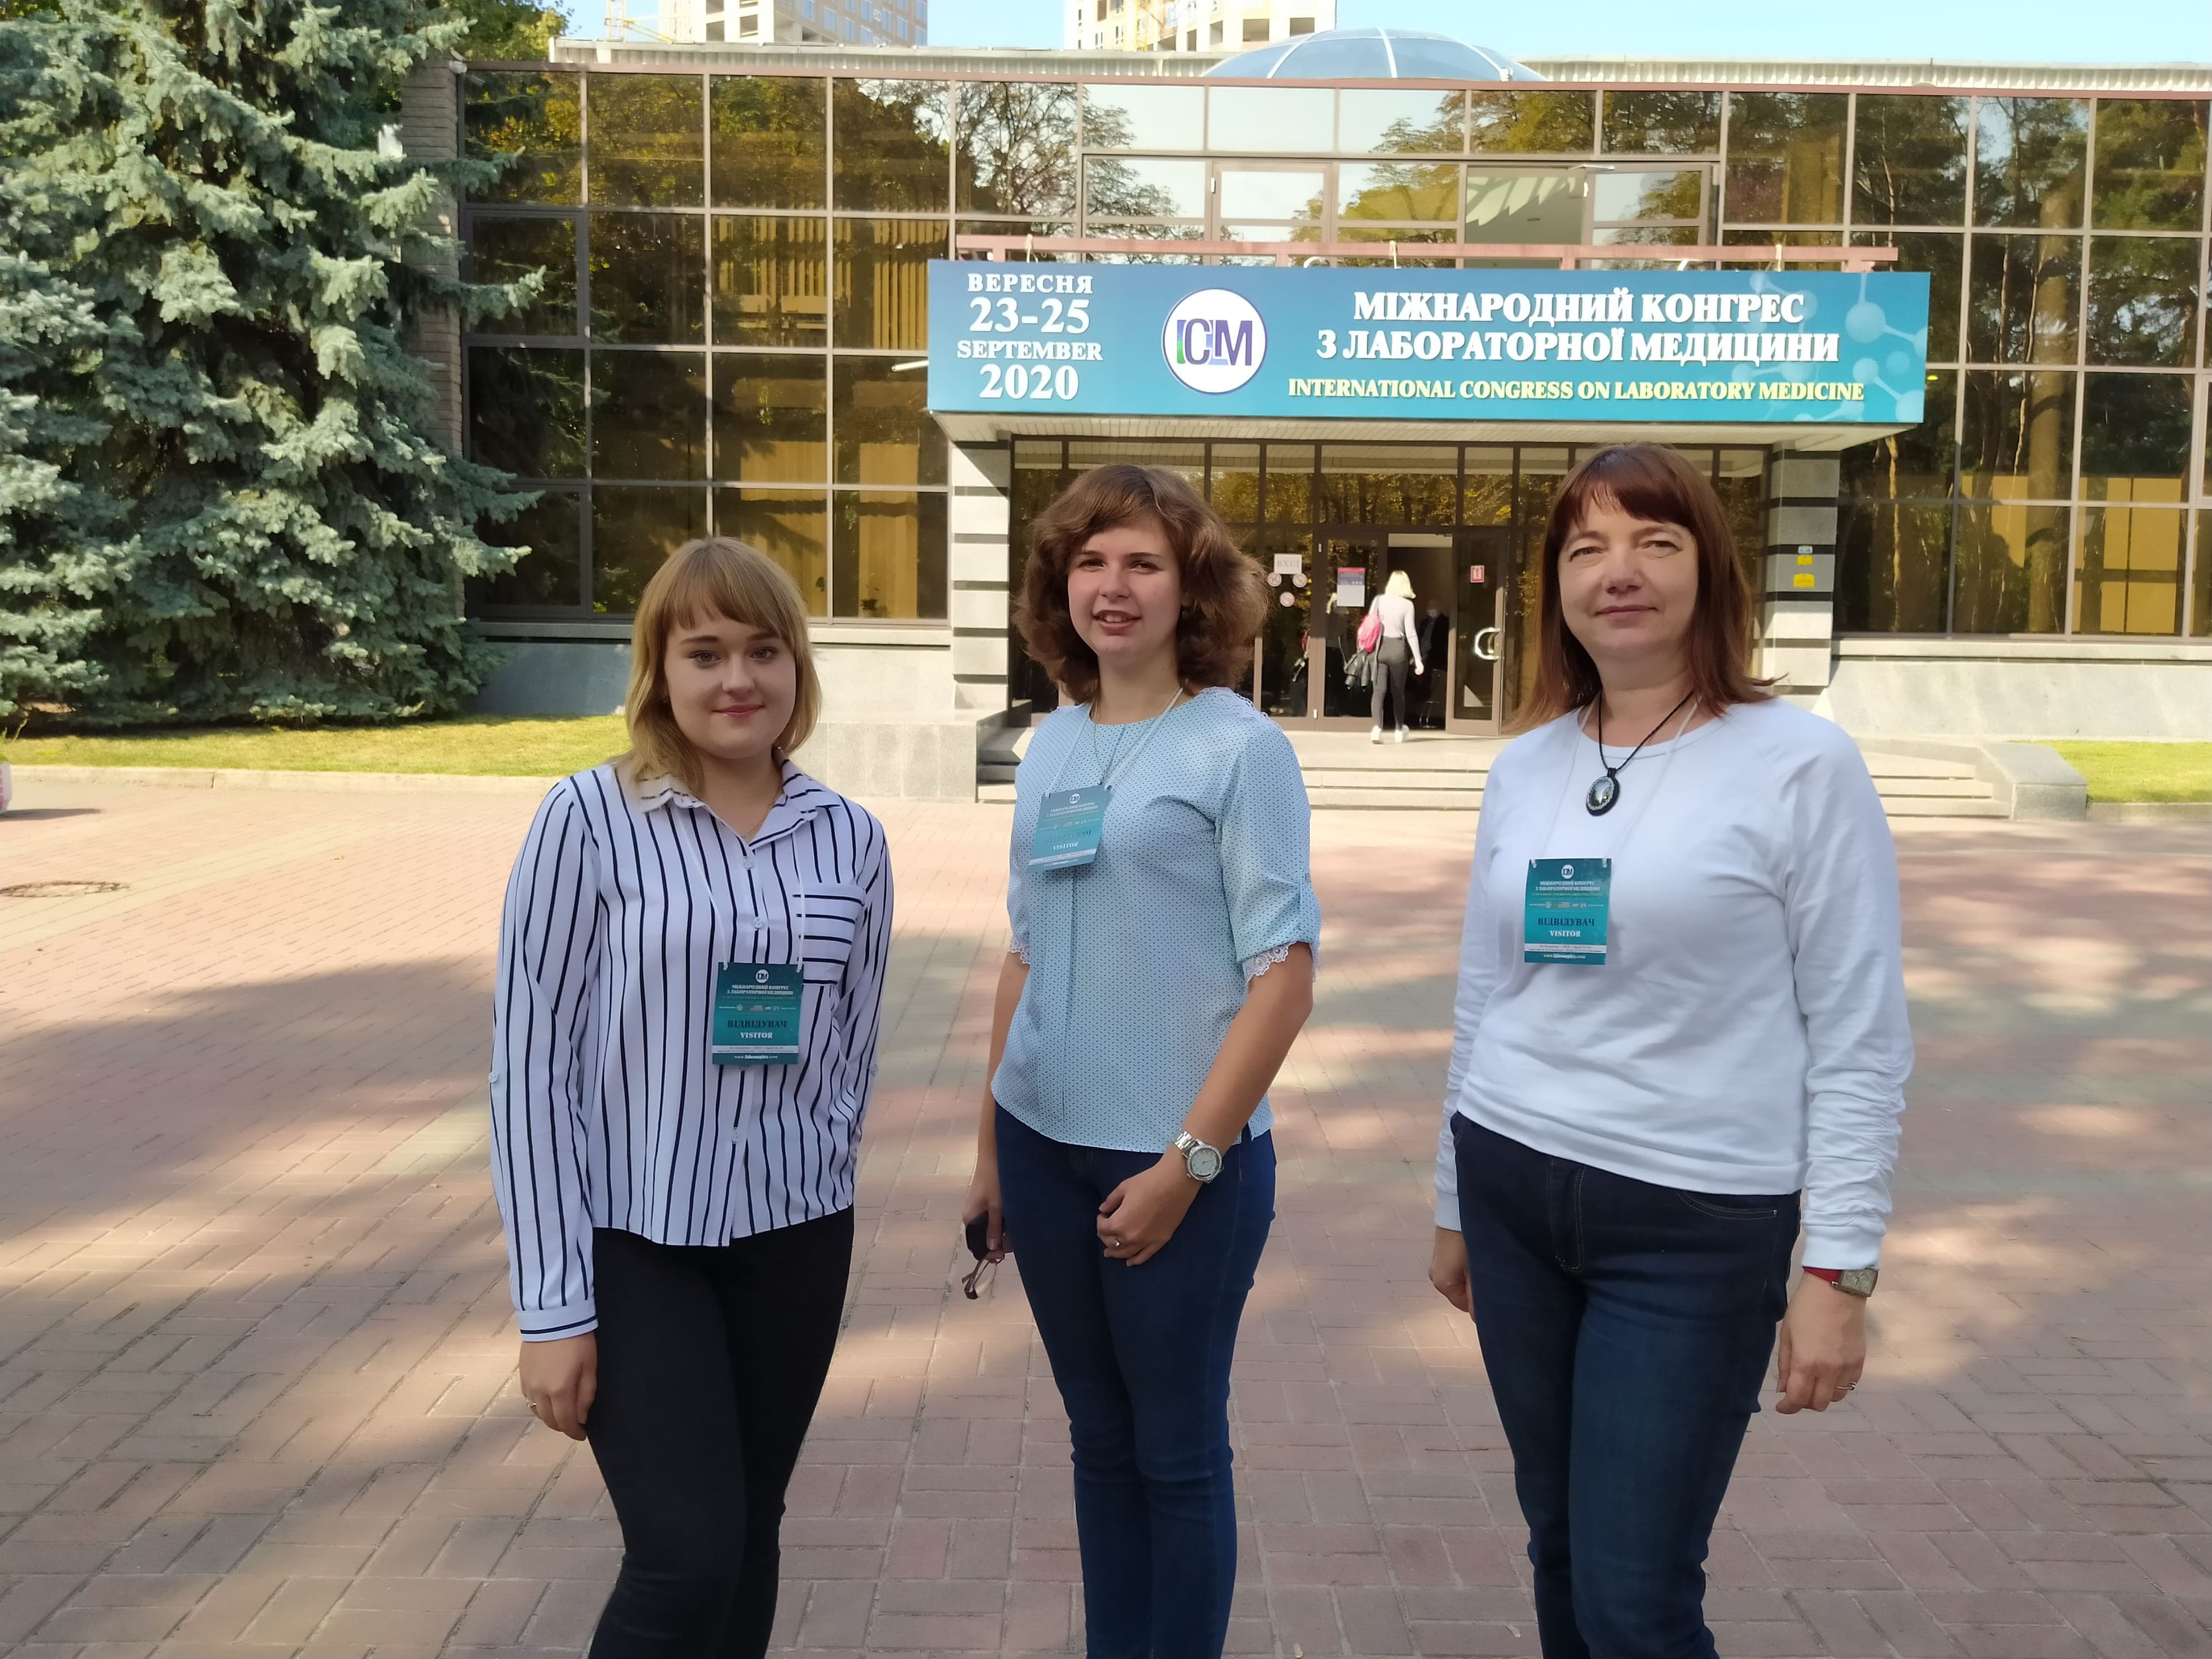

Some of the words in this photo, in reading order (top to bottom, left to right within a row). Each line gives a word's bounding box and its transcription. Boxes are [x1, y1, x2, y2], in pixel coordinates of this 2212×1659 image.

[967, 273, 1093, 294] ВЕРЕСНЯ
[969, 296, 1090, 334] 23-25
[1353, 287, 1635, 328] МІЖНАРОДНИЙ
[1640, 293, 1805, 323] КОНГРЕС
[957, 339, 1104, 361] SEPTEMBER
[1316, 329, 1338, 359] З
[1342, 327, 1625, 362] ЛАБОРАТОРНОЇ
[1630, 332, 1840, 368] МЕДИЦИНИ
[979, 363, 1080, 400] 2020
[1288, 378, 1457, 398] INTERNATIONAL
[1459, 380, 1574, 400] CONGRESS
[1577, 381, 1611, 400] ON
[1614, 381, 1756, 400] LABORATORY
[1758, 382, 1865, 402] MEDICINE
[1052, 841, 1079, 851] VISITOR
[1537, 917, 1595, 927] ВІДВІДУВАЧ
[727, 1020, 787, 1028] ВІДВІДУВАЧ
